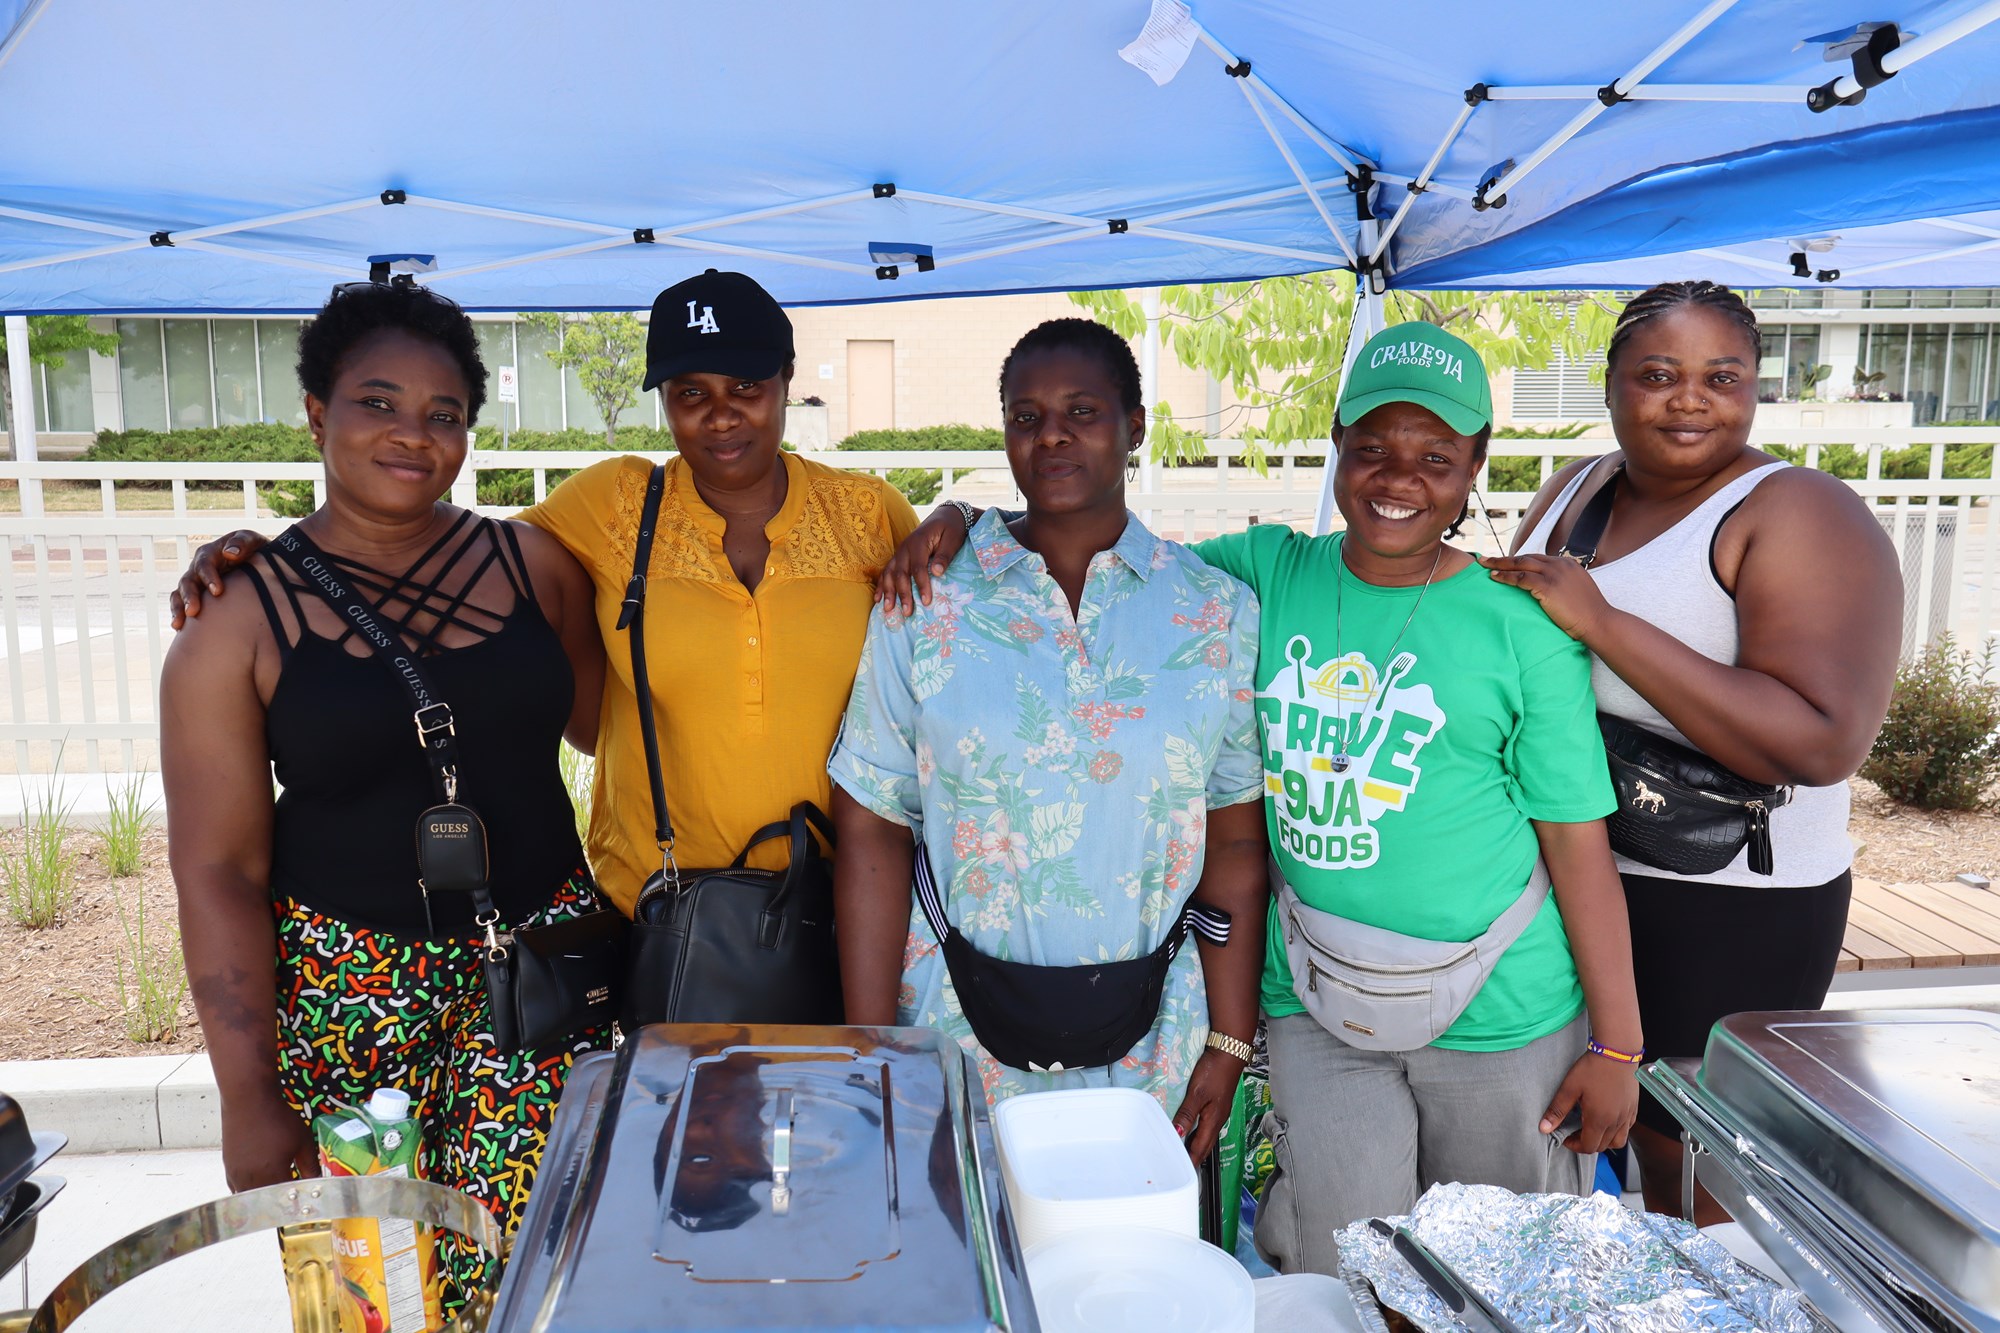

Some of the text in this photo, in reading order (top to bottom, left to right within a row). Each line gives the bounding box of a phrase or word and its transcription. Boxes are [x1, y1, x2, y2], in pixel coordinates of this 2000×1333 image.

[687, 300, 720, 334] LA
[1370, 341, 1463, 383] CRAVE9JA
[1397, 356, 1432, 368] FOODS
[302, 556, 346, 598] GUESS
[347, 605, 391, 648] GUESS
[1255, 697, 1433, 787] CRAVE
[1283, 769, 1362, 827] 9JA
[430, 823, 469, 833] GUESS
[1279, 816, 1373, 863] FOODS
